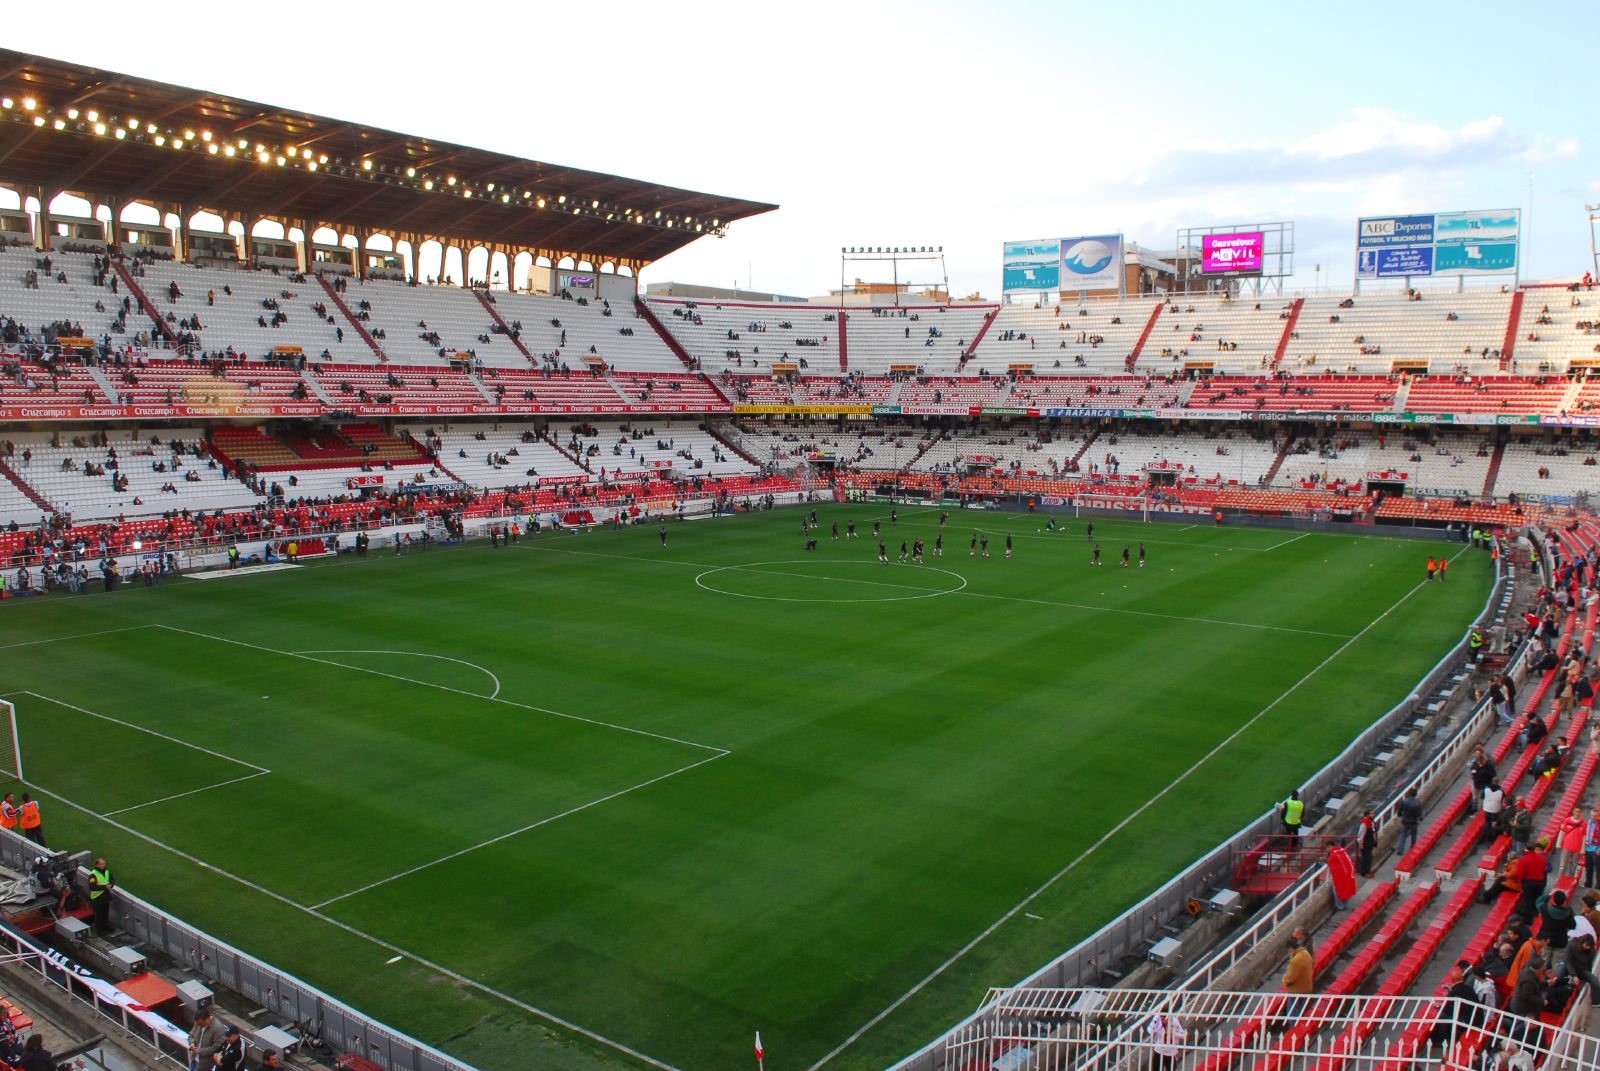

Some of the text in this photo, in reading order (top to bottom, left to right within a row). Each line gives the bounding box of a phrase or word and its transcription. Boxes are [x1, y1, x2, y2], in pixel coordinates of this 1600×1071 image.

[1365, 222, 1432, 234] ABC Deportes
[1211, 238, 1255, 248] Carrefour
[21, 408, 65, 417] Cruzcampo
[80, 408, 121, 416] Cruzcampo
[134, 407, 174, 416] Cruzcampo
[186, 407, 224, 415] Cruzcampo
[235, 406, 270, 414] Cruzcampo
[281, 406, 314, 414] Cruzcampo
[437, 405, 464, 413] Cruzcampo
[1065, 409, 1112, 417] RAFARCA
[1374, 414, 1396, 422] 888
[1414, 415, 1437, 423] 888
[1498, 416, 1521, 424] 888
